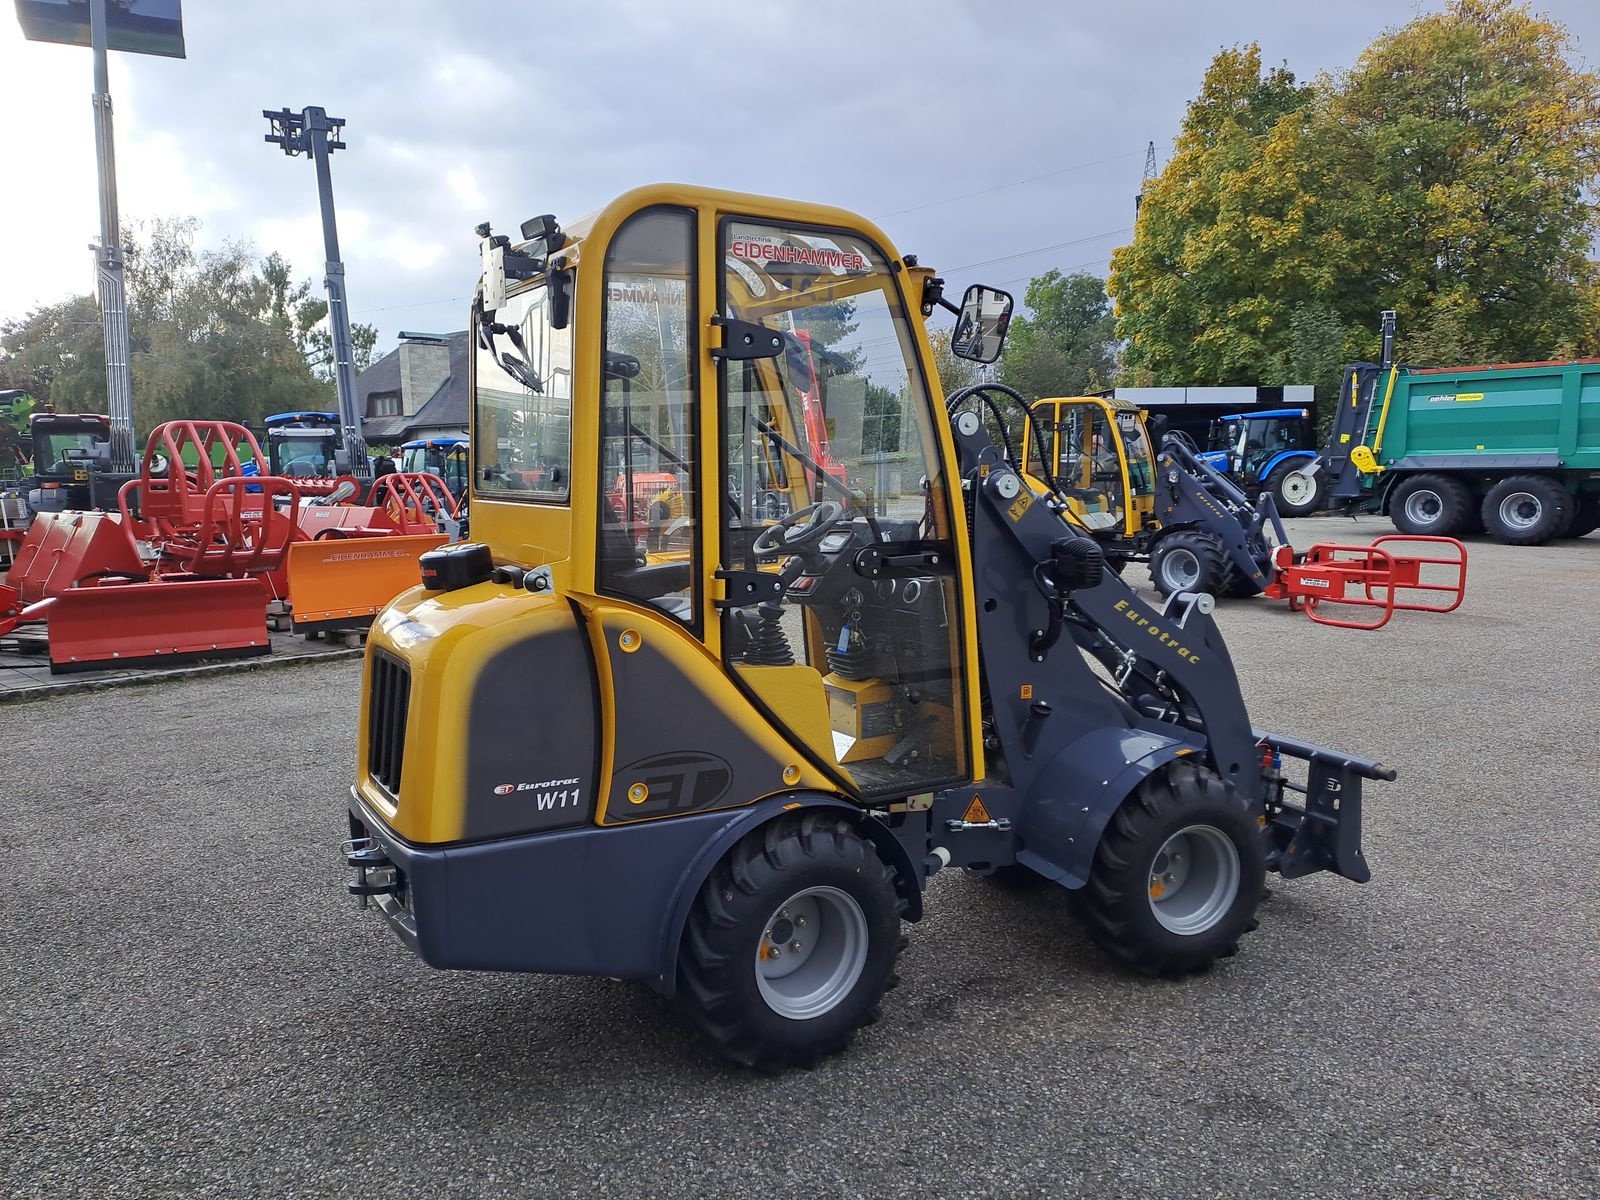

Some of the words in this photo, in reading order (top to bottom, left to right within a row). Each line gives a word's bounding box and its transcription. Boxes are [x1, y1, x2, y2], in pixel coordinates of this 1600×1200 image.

[733, 233, 773, 243] Landtechnik
[731, 241, 865, 270] EIDENHAMMER
[331, 549, 405, 561] EIDENHAMMER
[1113, 599, 1200, 665] Eurotrac
[517, 777, 580, 791] Eurotrac
[536, 788, 580, 811] W11
